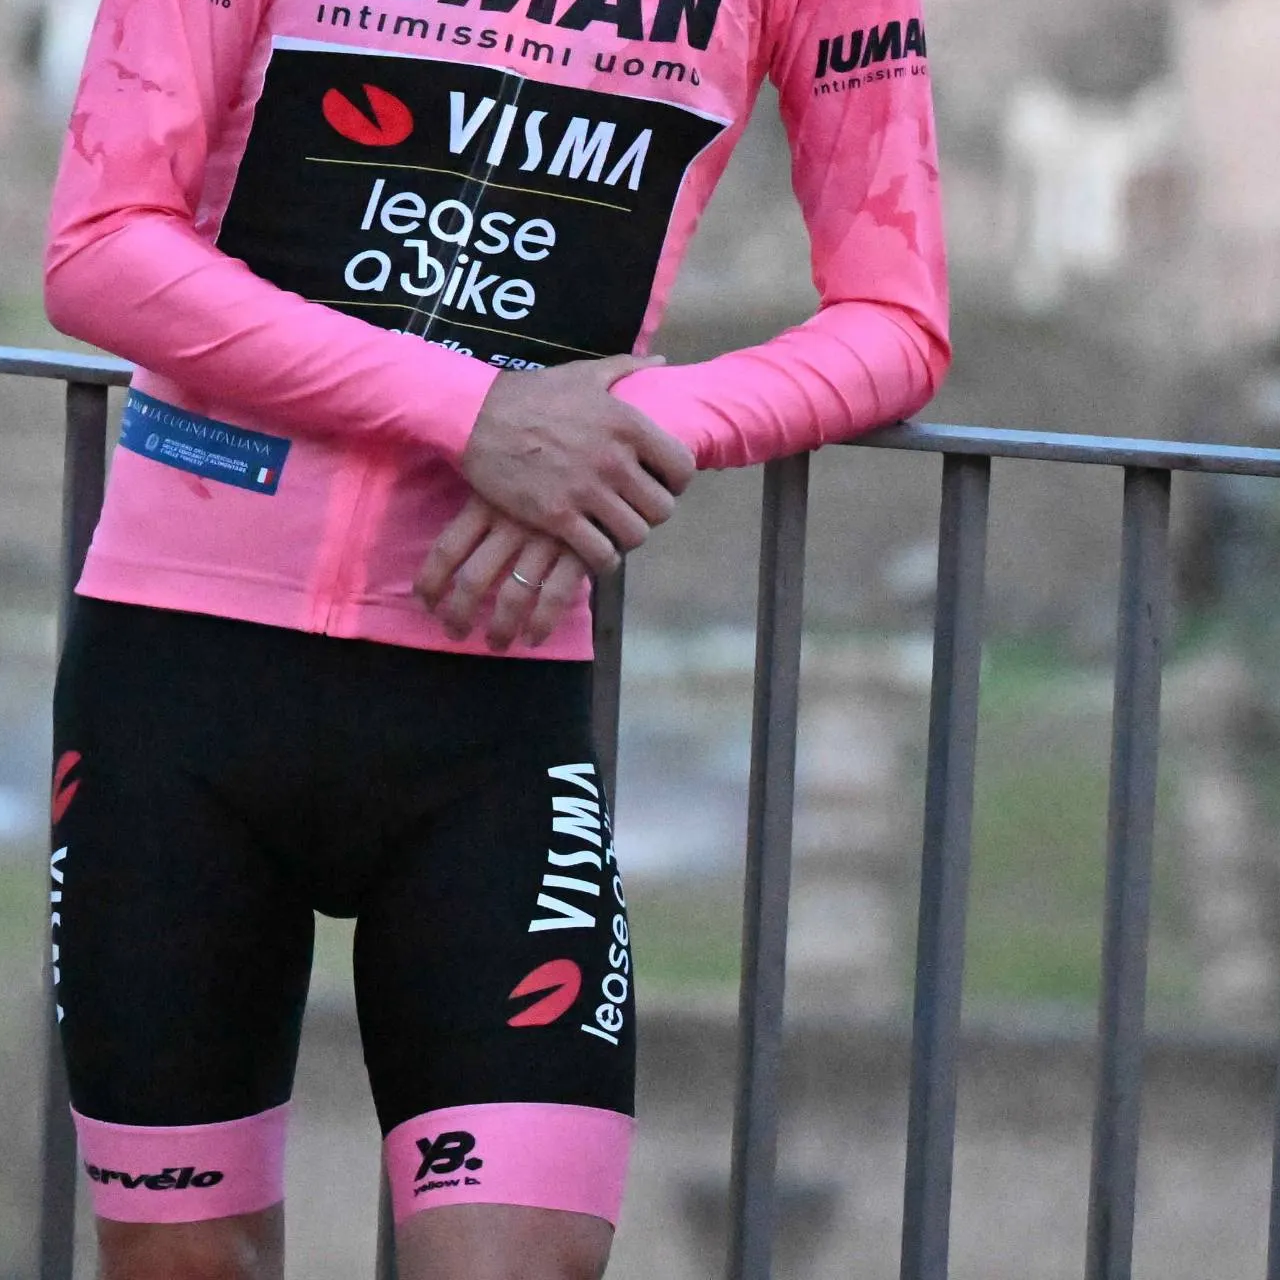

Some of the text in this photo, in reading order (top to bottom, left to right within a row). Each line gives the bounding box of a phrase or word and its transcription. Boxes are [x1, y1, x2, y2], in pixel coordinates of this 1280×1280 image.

[316, 4, 571, 66] intimissimi
[450, 91, 652, 191] VISMA
[361, 178, 556, 261] lease
[210, 429, 270, 457] ITALIANA
[528, 763, 602, 932] VISMA
[580, 914, 628, 1046] lease
[84, 1161, 224, 1190] ervélo
